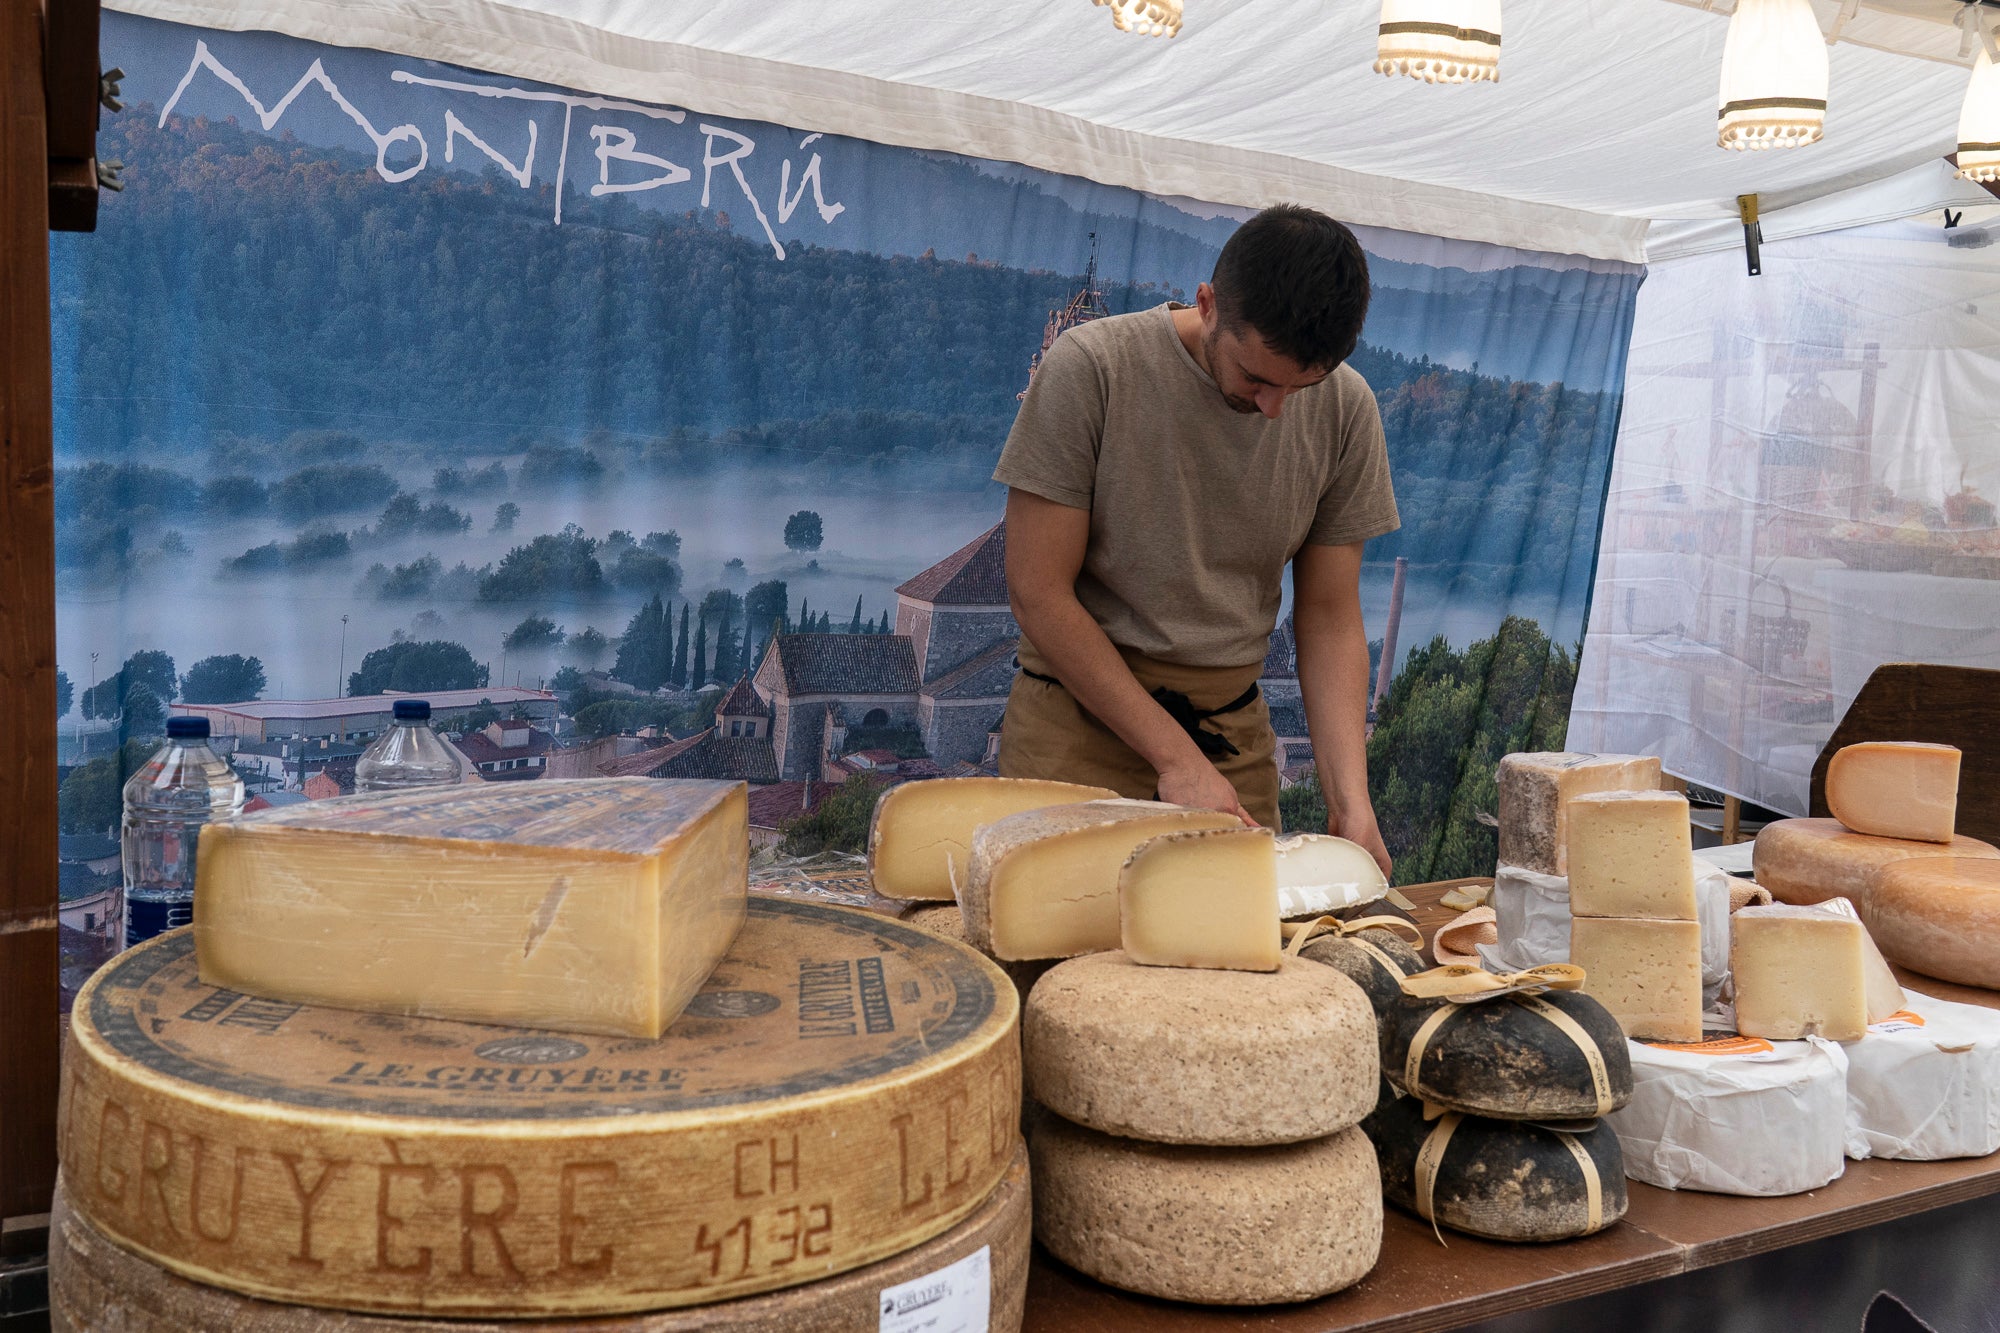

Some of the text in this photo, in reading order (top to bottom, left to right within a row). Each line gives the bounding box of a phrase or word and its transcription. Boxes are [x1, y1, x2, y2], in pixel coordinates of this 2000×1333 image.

[343, 1062, 414, 1079] LE
[97, 1099, 617, 1282] GRUYÈRE
[734, 1134, 799, 1199] CH
